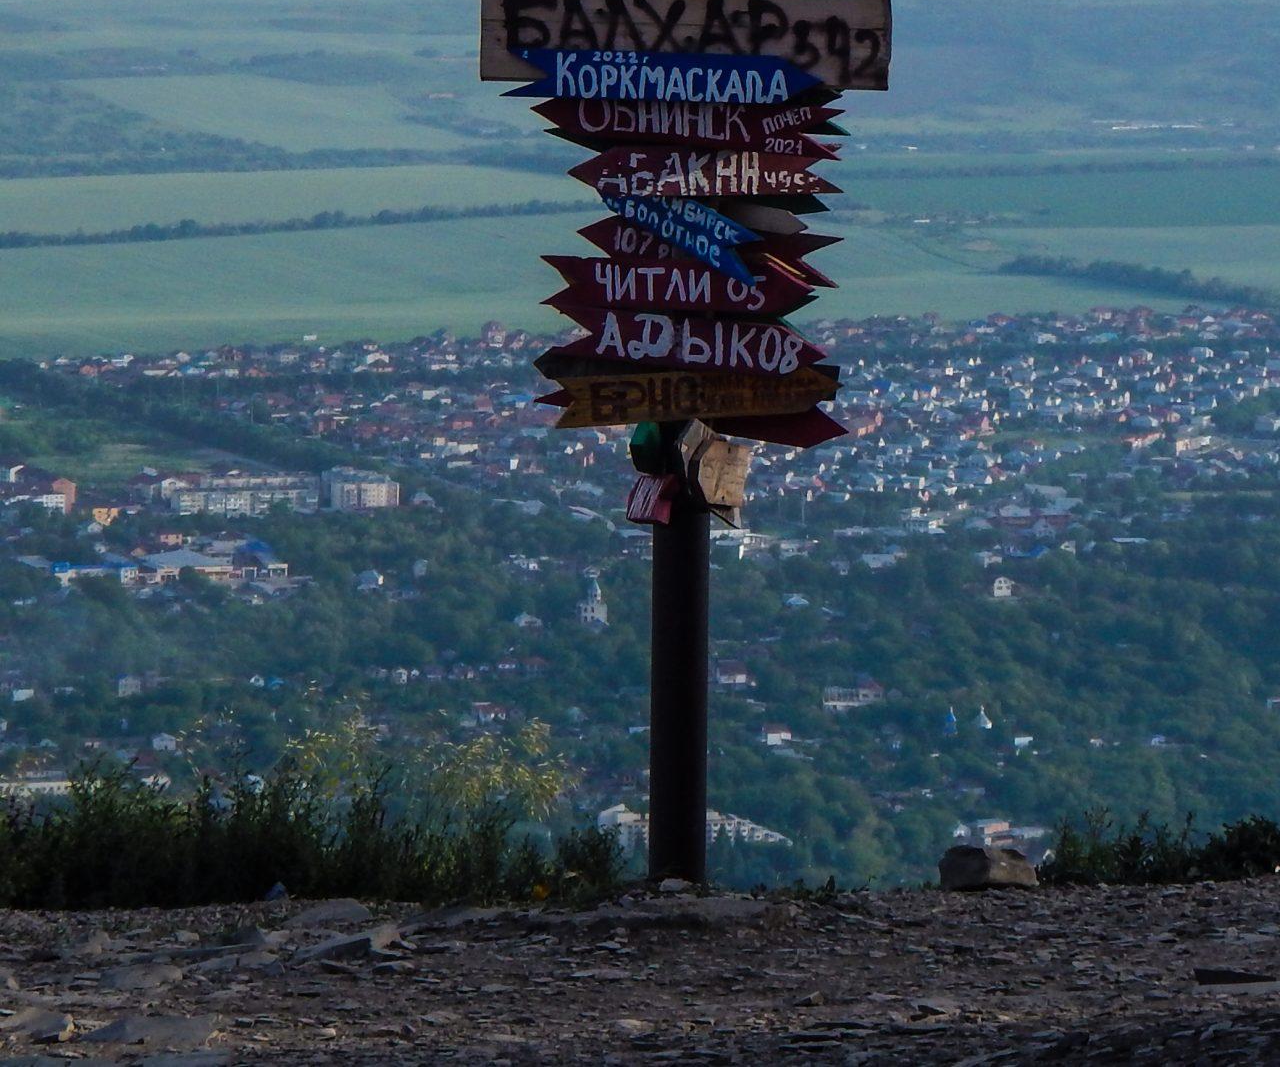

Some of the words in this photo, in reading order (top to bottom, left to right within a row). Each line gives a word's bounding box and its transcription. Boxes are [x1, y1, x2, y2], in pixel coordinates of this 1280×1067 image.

[578, 99, 751, 143] ОБНИНСК
[761, 106, 812, 135] ПОЧЕП
[764, 137, 804, 155] 2021
[595, 262, 712, 303] ЧИТЛИ
